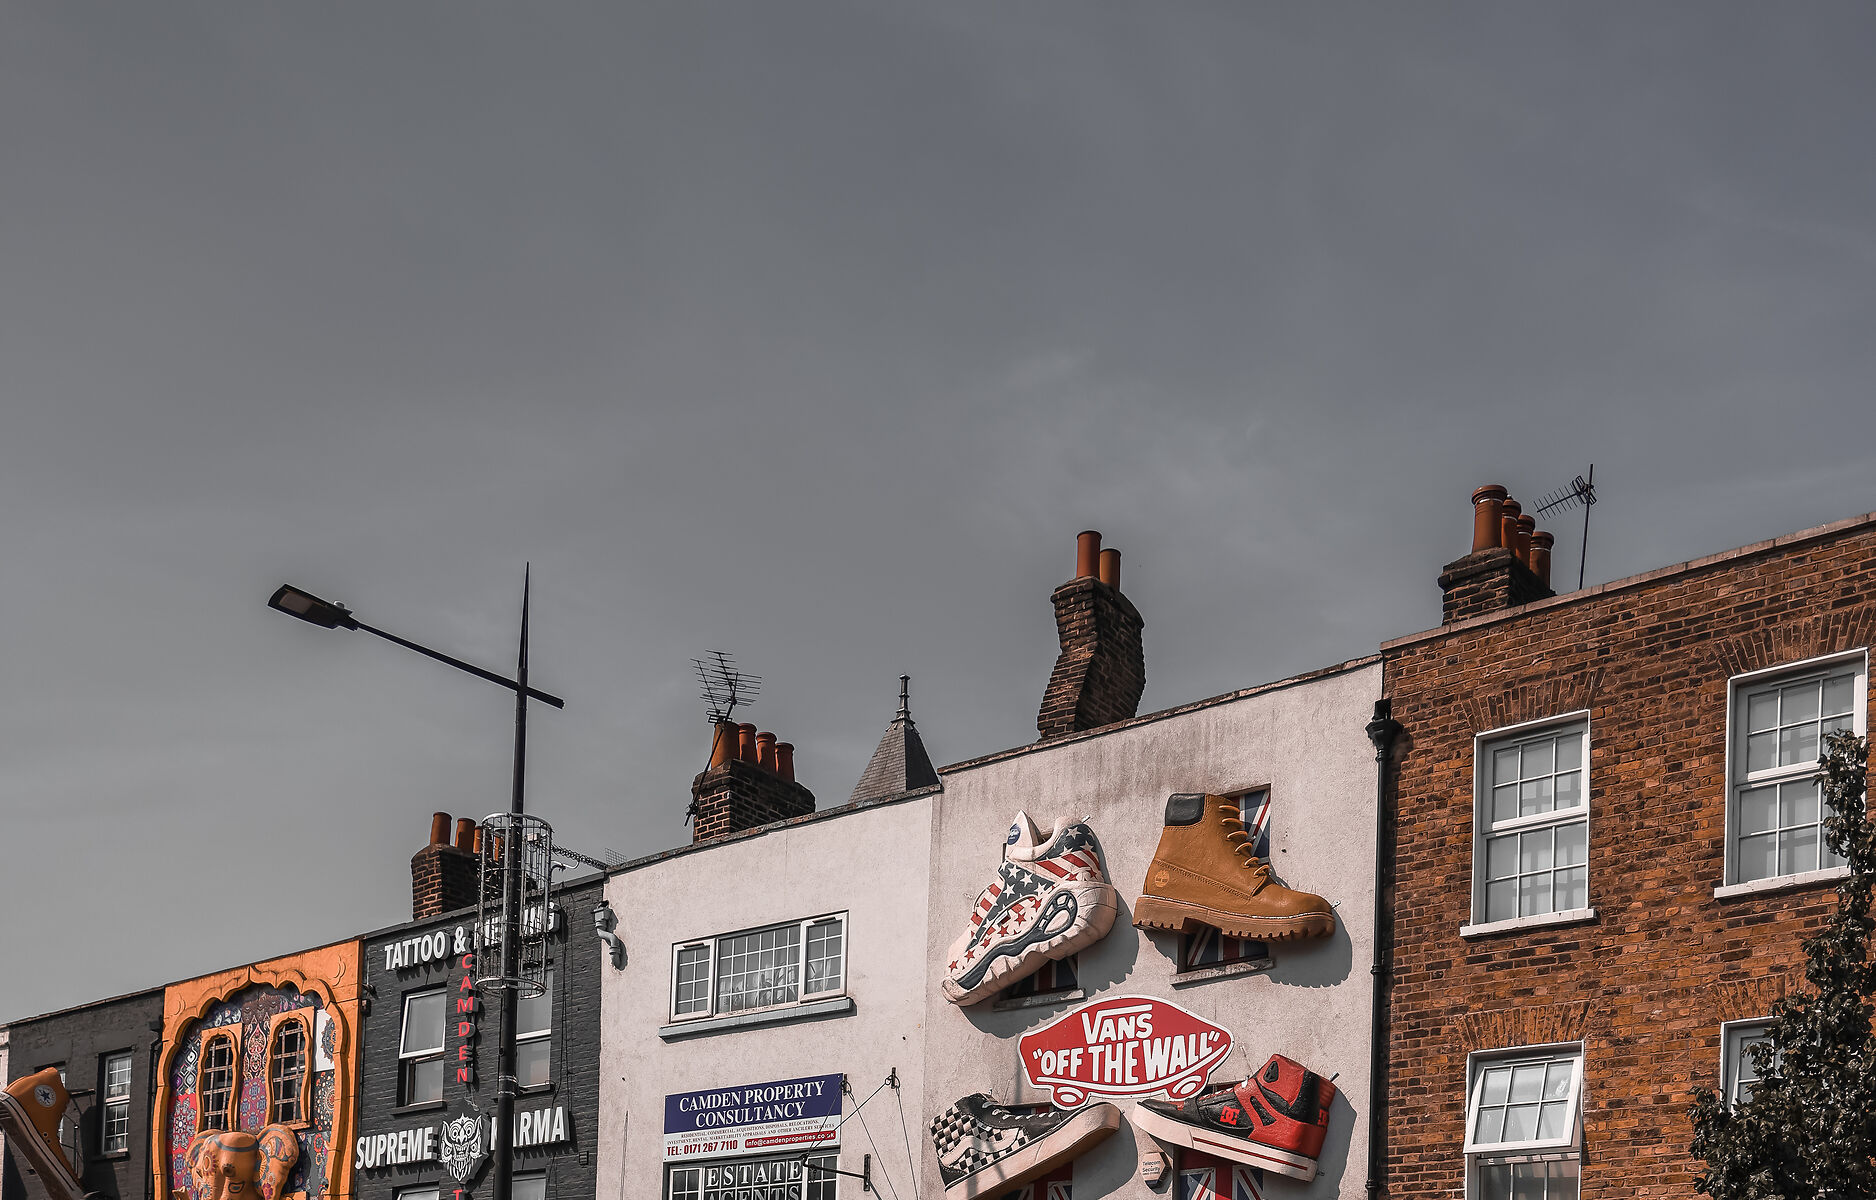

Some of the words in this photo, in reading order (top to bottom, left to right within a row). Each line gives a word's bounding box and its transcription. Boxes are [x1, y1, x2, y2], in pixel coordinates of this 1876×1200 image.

[384, 931, 446, 970] TATTOO
[454, 926, 467, 954] &
[457, 954, 474, 1084] CAMDEN
[1081, 1004, 1153, 1044] VANS
[1033, 1048, 1084, 1077] "OFF
[1087, 1041, 1139, 1084] THE
[1142, 1030, 1220, 1081] WALL"
[679, 1091, 741, 1112] CAMDEN
[744, 1080, 825, 1105] PROPERTY
[695, 1101, 806, 1128] CONSULTANCY
[355, 1126, 434, 1169] SUPREME
[667, 1146, 682, 1156] TEL:
[684, 1143, 702, 1155] 0171
[703, 1142, 718, 1153] 267
[720, 1140, 738, 1151] 7110
[706, 1160, 802, 1188] ESTATE
